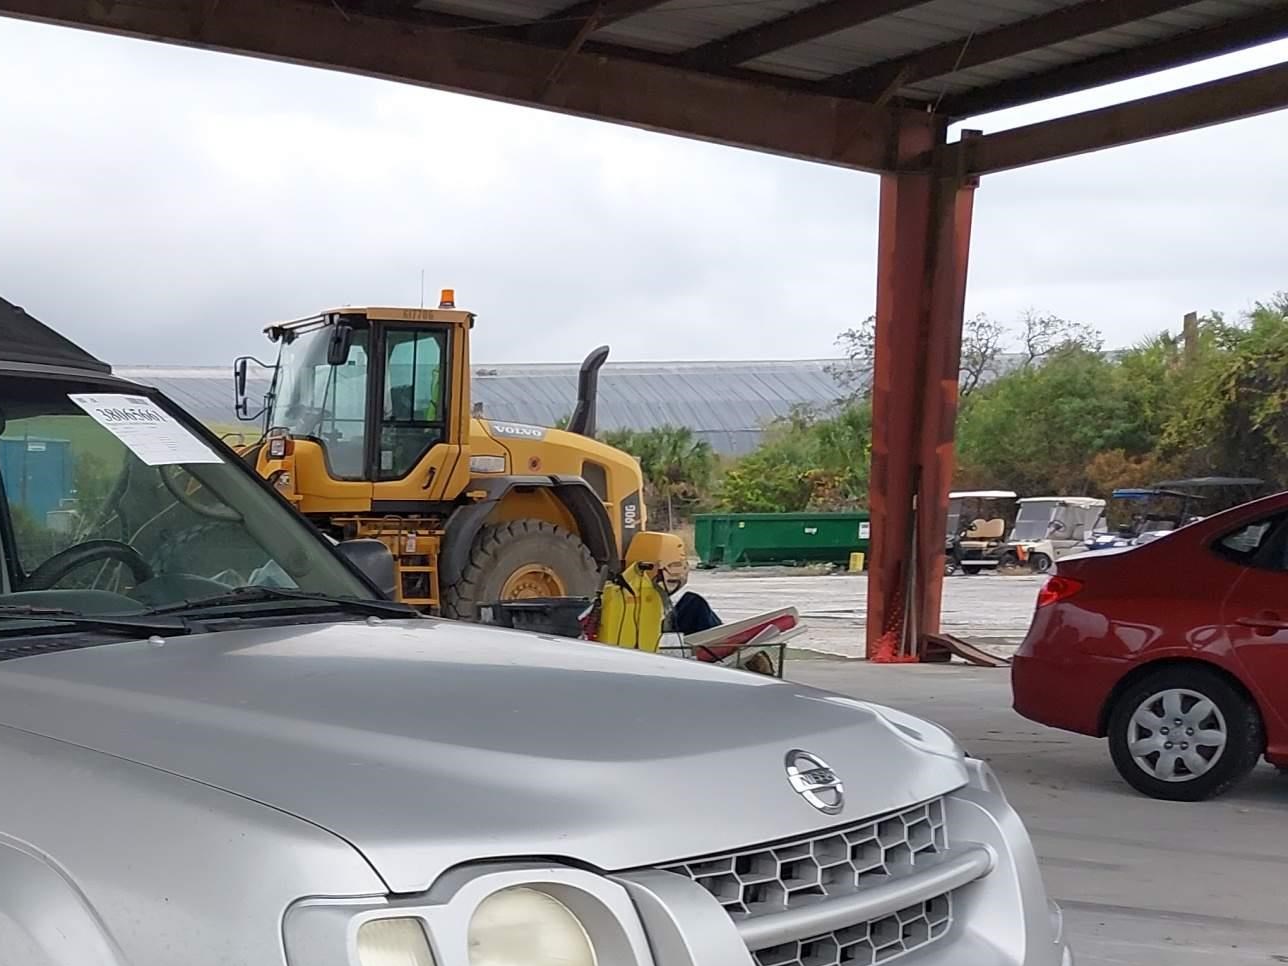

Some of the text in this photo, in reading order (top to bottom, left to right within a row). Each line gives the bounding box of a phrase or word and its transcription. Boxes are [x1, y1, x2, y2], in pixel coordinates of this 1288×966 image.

[96, 408, 169, 422] 38065661
[493, 425, 543, 436] VOLVO
[624, 504, 636, 529] L90G
